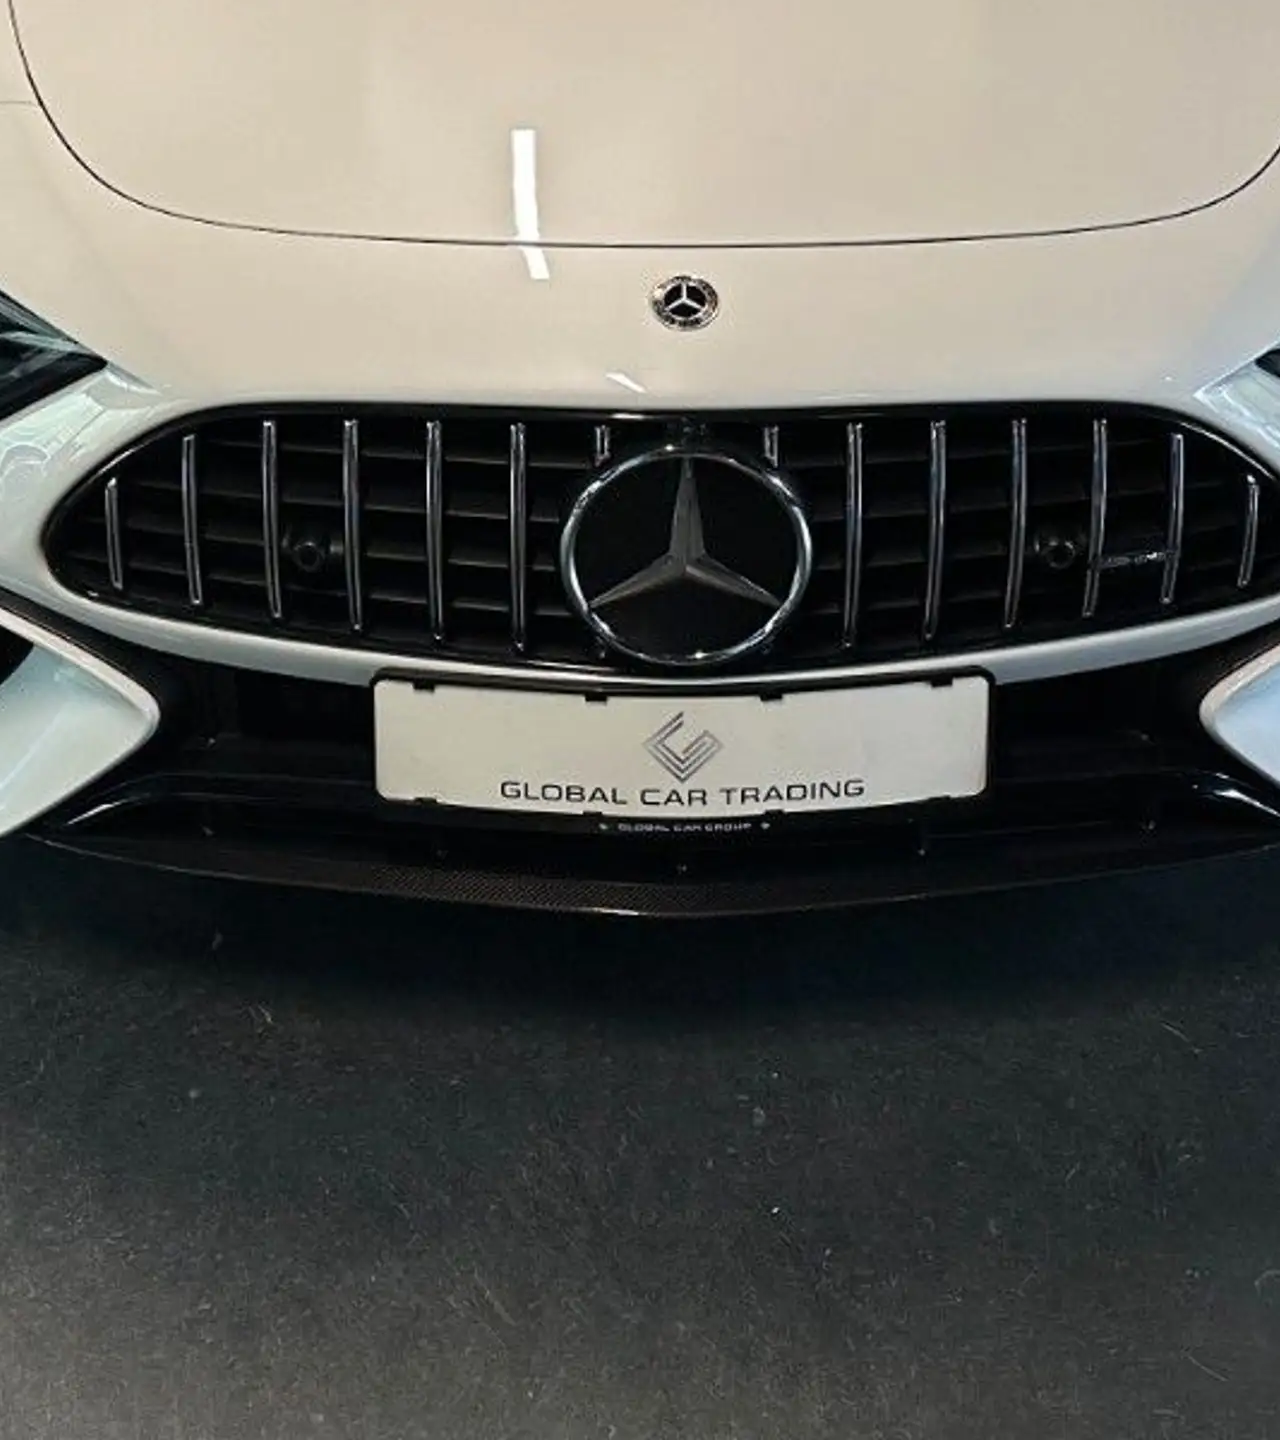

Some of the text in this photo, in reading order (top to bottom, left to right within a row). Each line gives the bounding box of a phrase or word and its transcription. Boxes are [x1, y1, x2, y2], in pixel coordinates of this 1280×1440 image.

[500, 779, 865, 806] GLOBAL CAR TRADING
[617, 822, 671, 832] GLOBAL
